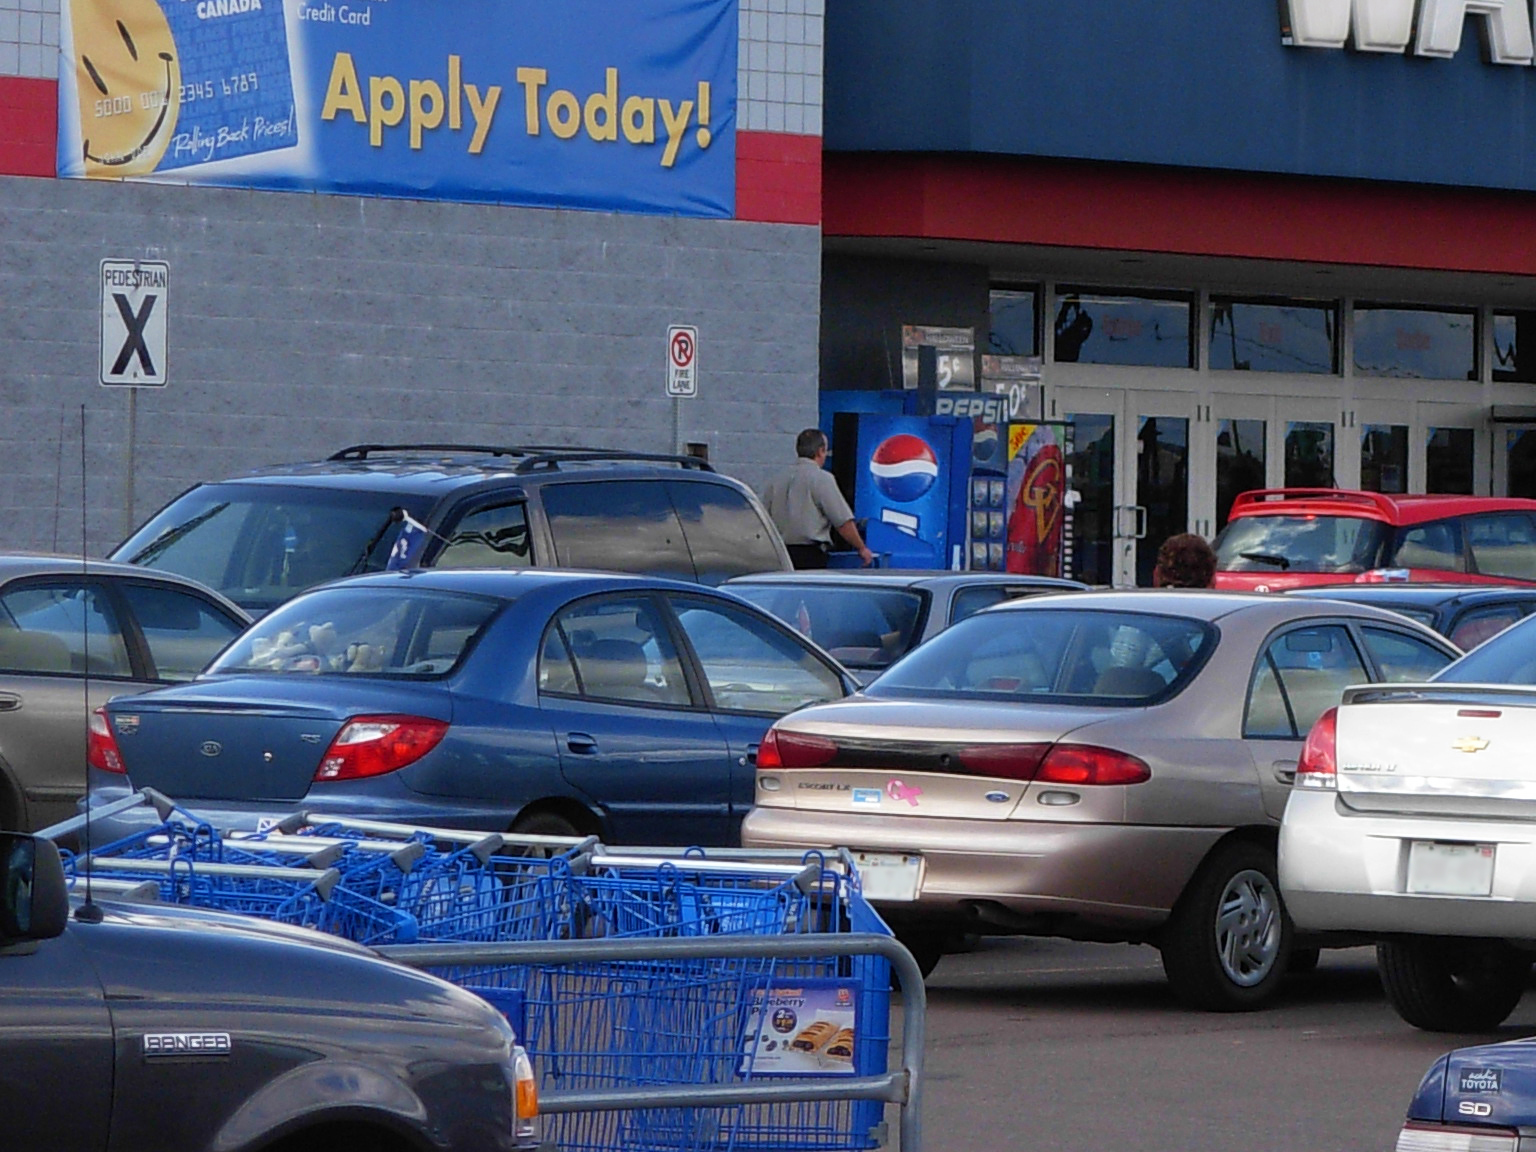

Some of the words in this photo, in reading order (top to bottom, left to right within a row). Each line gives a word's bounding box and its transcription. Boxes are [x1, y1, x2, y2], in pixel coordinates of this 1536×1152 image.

[297, 2, 336, 23] Credit
[339, 5, 371, 26] Card
[178, 80, 214, 104] 2345
[222, 73, 258, 95] 6789
[321, 51, 501, 154] Apply
[516, 67, 712, 168] Today!
[173, 125, 215, 162] Rolling
[217, 117, 248, 146] Back
[105, 269, 166, 288] PEDESTRIAN
[110, 293, 158, 376] X
[936, 398, 1002, 424] PEPSI
[147, 1035, 229, 1050] RANGER
[1461, 1079, 1499, 1090] TOYOTA
[1458, 1101, 1492, 1117] SD
